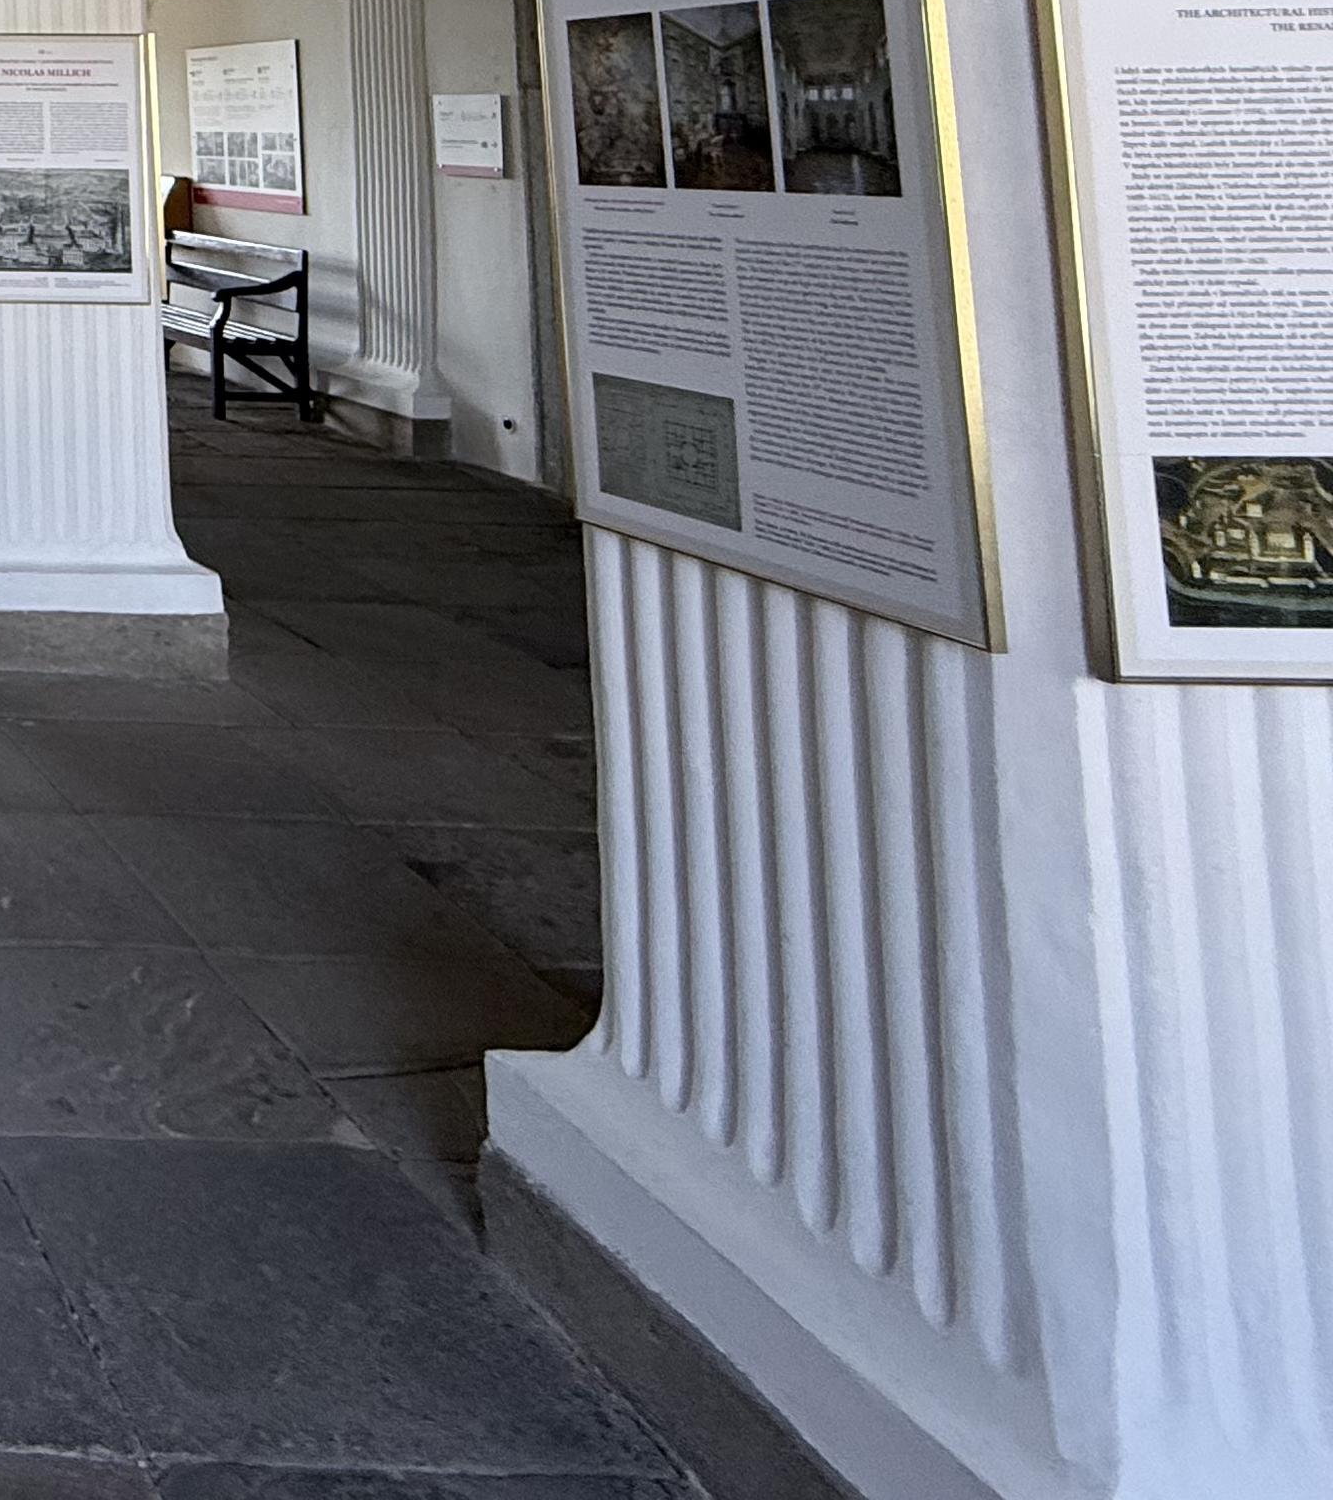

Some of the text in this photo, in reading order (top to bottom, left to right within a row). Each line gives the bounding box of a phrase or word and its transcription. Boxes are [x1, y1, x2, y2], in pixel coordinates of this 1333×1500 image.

[1176, 9, 1201, 18] THE
[1203, 8, 1305, 18] ARCHITECTURAL
[1, 68, 91, 77] NICOLAS MILLICH
